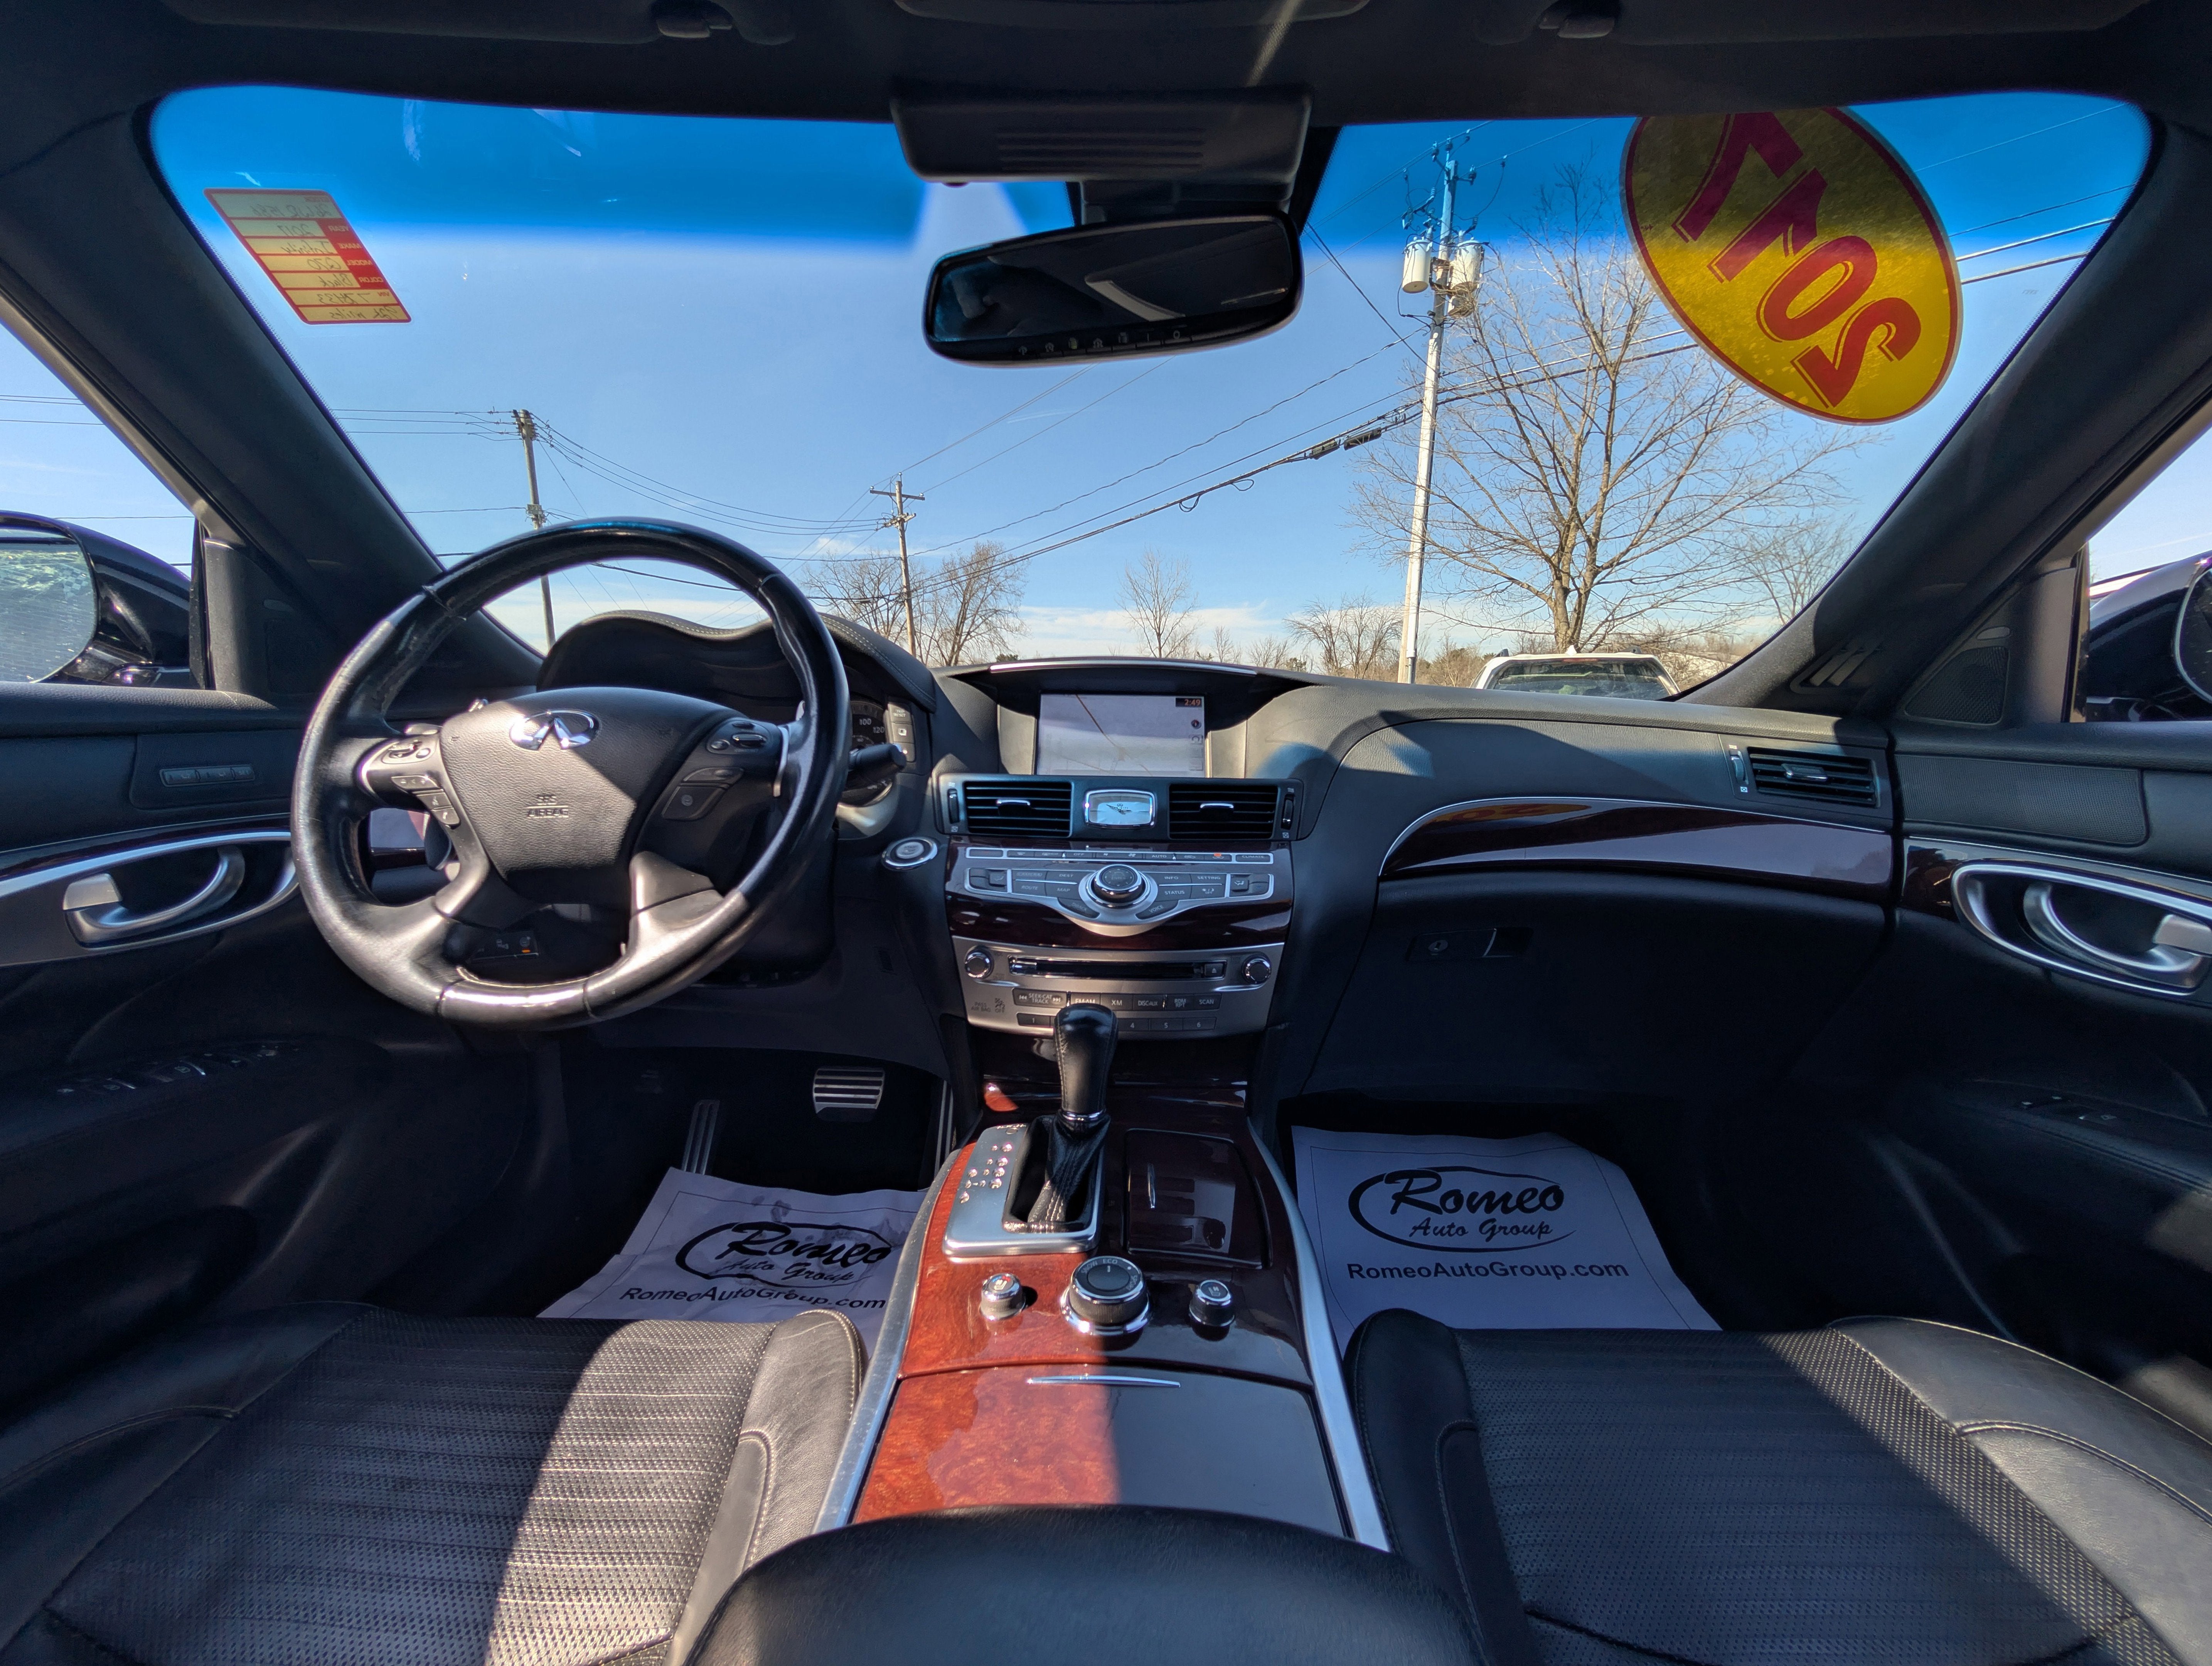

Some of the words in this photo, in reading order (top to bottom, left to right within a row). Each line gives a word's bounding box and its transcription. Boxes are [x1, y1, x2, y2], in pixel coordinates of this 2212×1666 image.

[1149, 905, 1164, 913] VOICE
[1383, 1169, 1565, 1216] Romeo
[1409, 1216, 1469, 1238] Auto
[1478, 1219, 1553, 1242] Group
[715, 1221, 892, 1267] Romeo
[722, 1257, 776, 1273] Auto
[780, 1261, 854, 1283] Group
[1346, 1261, 1629, 1280] RomeoAutoGroup.com
[619, 1287, 887, 1309] RomeoAutoGroup.com
